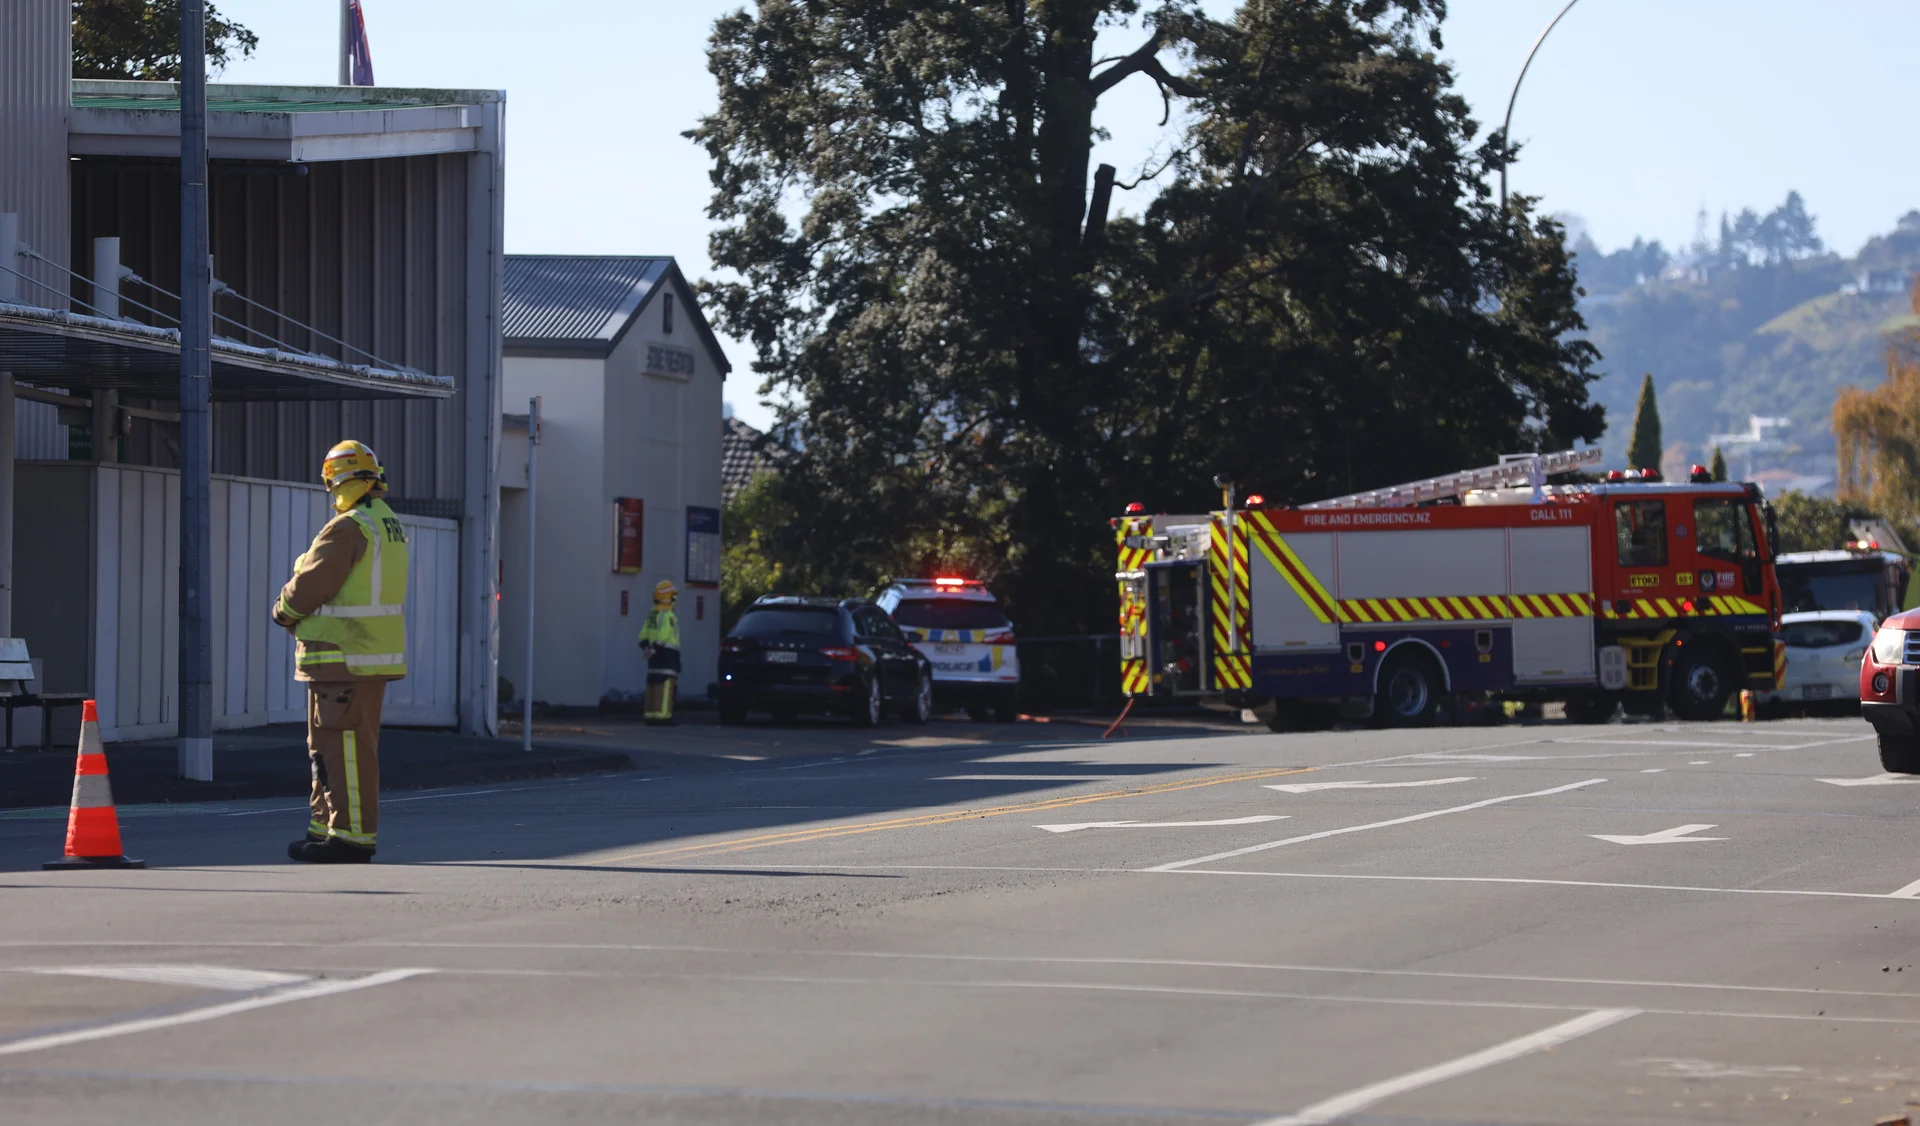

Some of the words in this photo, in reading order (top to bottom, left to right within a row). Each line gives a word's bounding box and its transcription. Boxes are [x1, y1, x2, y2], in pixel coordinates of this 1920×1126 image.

[1304, 514, 1327, 525] FIRE
[1329, 513, 1351, 525] AND
[1353, 512, 1430, 525] EMERGENCY.NZ
[1531, 508, 1557, 521] CALL
[1559, 508, 1572, 520] 111
[381, 517, 405, 544] FIRE
[1717, 572, 1735, 582] FIRE
